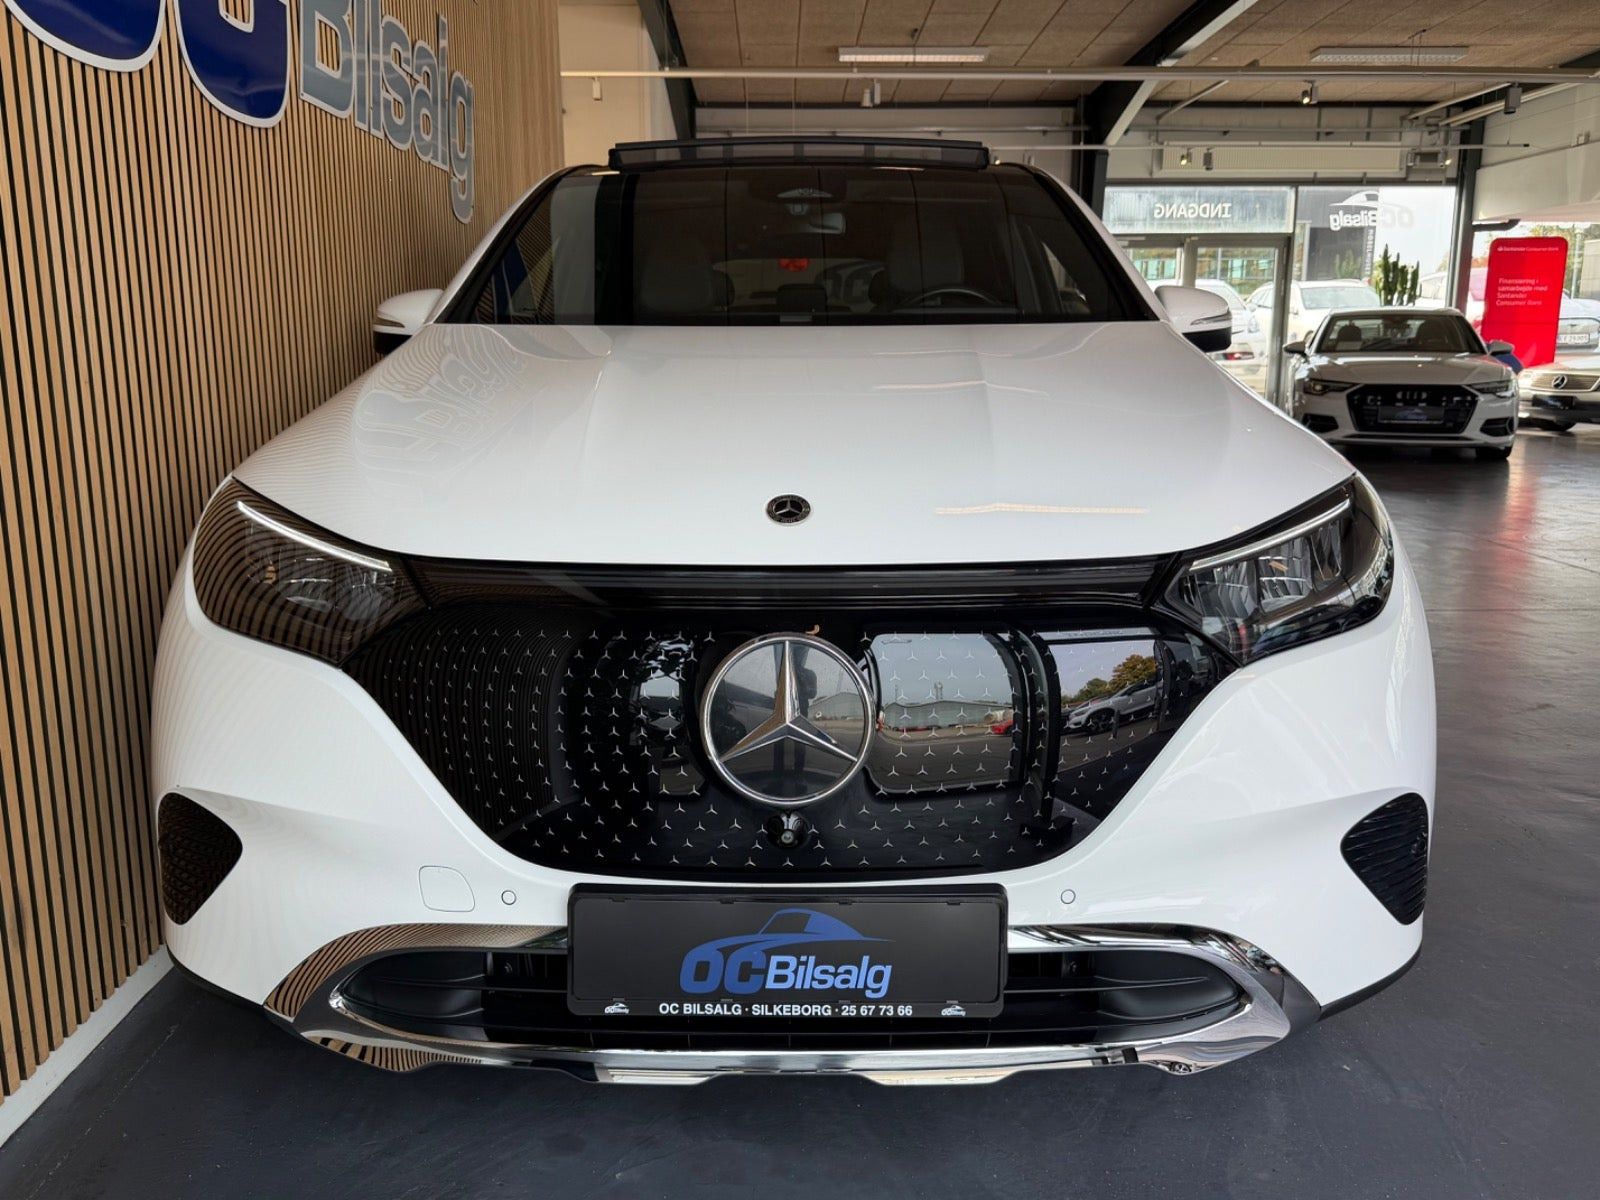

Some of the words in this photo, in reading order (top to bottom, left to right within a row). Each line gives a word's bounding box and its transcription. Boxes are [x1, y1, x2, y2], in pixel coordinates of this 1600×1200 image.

[659, 1003, 680, 1015] OC
[682, 1003, 742, 1016] BILSALG
[751, 1004, 832, 1016] SILKEBORG
[841, 1005, 857, 1016] 25
[859, 1005, 876, 1016] 67
[878, 1005, 894, 1016] 73
[897, 1005, 913, 1016] 66
